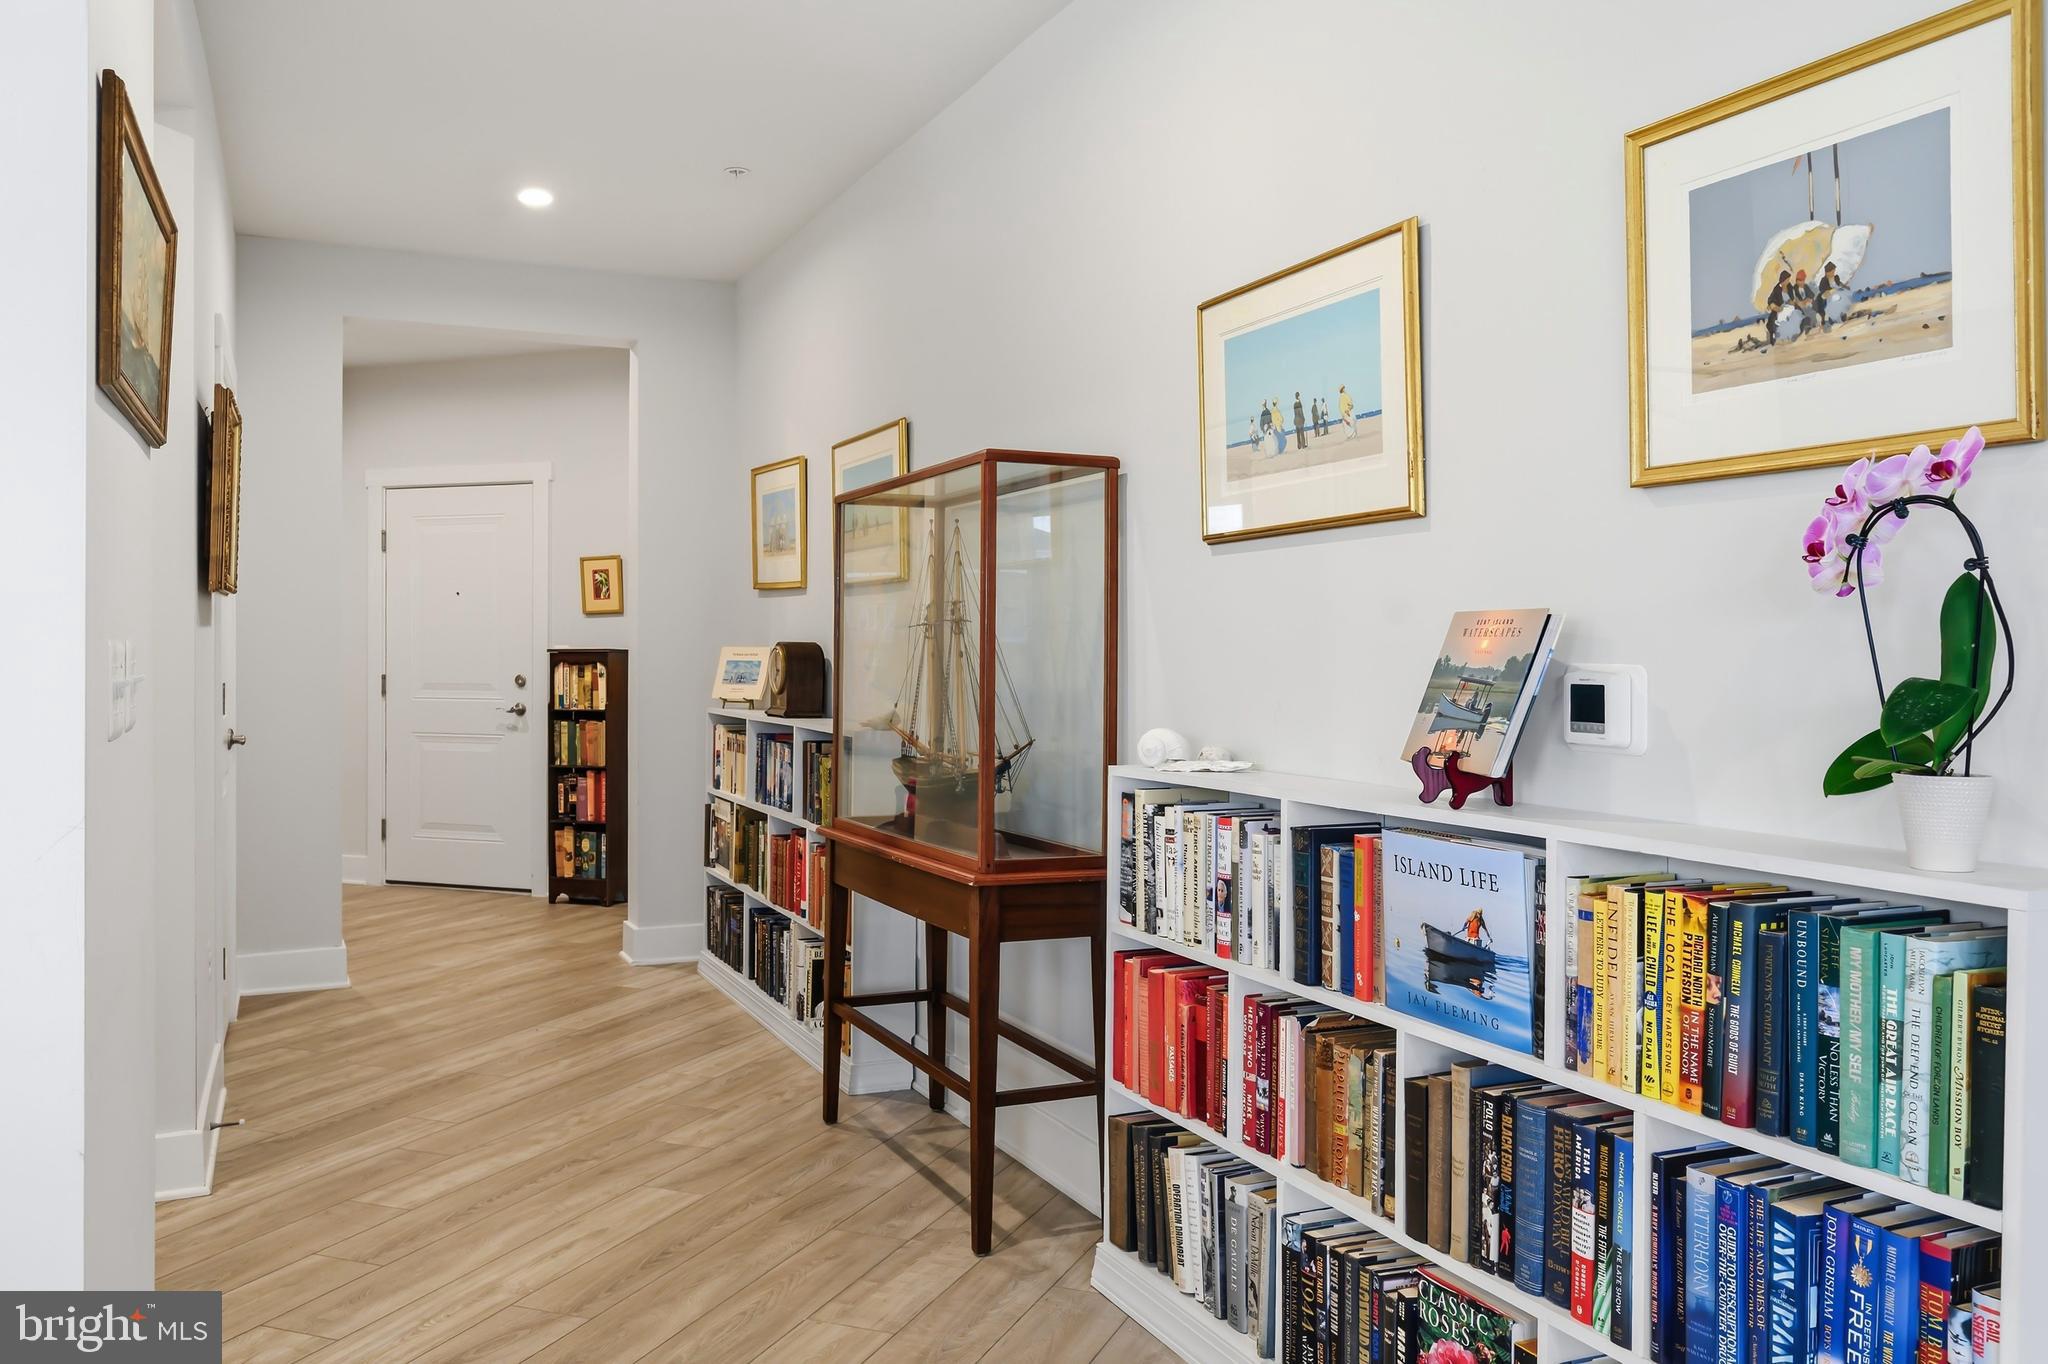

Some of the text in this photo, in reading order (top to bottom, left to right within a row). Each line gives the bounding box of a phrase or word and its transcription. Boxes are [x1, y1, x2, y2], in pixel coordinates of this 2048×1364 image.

[1462, 627, 1523, 638] WATERSCAPES
[1394, 854, 1500, 892] ISLAND LIFE
[1608, 900, 1618, 985] INFIDEL
[1646, 915, 1657, 934] LEE
[1666, 897, 1676, 983] THE LOCAL
[1596, 911, 1604, 999] LETTERS TO JUDY
[1646, 956, 1656, 987] CHILD
[1682, 932, 1692, 1005] PATTERSON
[1692, 934, 1704, 1007] RICHARD NORTH
[1710, 936, 1718, 972] HOFFMAN
[1731, 920, 1743, 996] MICHAEL CONNELLY
[1796, 920, 1808, 988] UNBOUND
[1407, 991, 1500, 1031] JAY FLEMING
[1646, 1020, 1653, 1034] NO
[1682, 1014, 1690, 1028] OF
[1850, 947, 1862, 1083] MY MOTHER/MY SELF
[1935, 1006, 1943, 1046] CHILDREN
[1689, 1011, 1700, 1084] IN THE NAME
[1728, 1004, 1740, 1075] THE GODS OF GUILT
[1885, 988, 1898, 1138] THE GREAT AIR RACE
[1934, 1048, 1942, 1059] OF
[1818, 1055, 1828, 1103] VICTORY
[1830, 1040, 1840, 1122] NO LESS THAN
[1907, 1008, 1922, 1146] THE DEEP END OCEAN
[1484, 1100, 1494, 1131] POLIO
[1501, 1114, 1512, 1150] BLACK
[1932, 1098, 1940, 1126] LANDS
[1954, 1066, 1965, 1150] MISSION BOY
[1372, 1156, 1379, 1165] IT
[1500, 1152, 1512, 1182] ECHO
[1598, 1144, 1608, 1220] MICHAEL CONNELLY
[1172, 1184, 1185, 1268] OPERATION DRUMBEAT
[1231, 1216, 1238, 1236] DE
[1552, 1183, 1562, 1248] DONOVAN
[1560, 1186, 1571, 1259] WILD BILL
[1250, 1213, 1260, 1278] Nelson DeMille
[1598, 1224, 1608, 1261] THE FIFTH
[1694, 1192, 1710, 1296] MATTERHORN
[1726, 1227, 1736, 1260] GUIDE
[1756, 1198, 1764, 1331] THE LIFE AND TIMES OF
[1773, 1222, 1795, 1290] AYN
[1823, 1212, 1837, 1320] JOHN GRISHAM
[1360, 1271, 1369, 1289] THE
[1676, 1235, 1684, 1322] SUPERIOR WOMEN
[1718, 1223, 1727, 1331] OVER-THE-COUNTER
[1726, 1262, 1736, 1276] TO
[1884, 1245, 1896, 1326] MICHAEL CONNELLY
[1301, 1276, 1314, 1332] 1944
[1330, 1292, 1338, 1336] MARTINI
[1418, 1280, 1488, 1336] CLASSIC
[1419, 1300, 1470, 1347] ROSES
[1726, 1278, 1736, 1355] PRESCRIPTION
[1864, 1302, 1872, 1314] IN
[1928, 1290, 1944, 1332] TOM
[1823, 1324, 1832, 1350] BOYS
[1883, 1330, 1894, 1347] THE
[1973, 1312, 1984, 1359] SHEEHY
[1987, 1319, 2000, 1344] GAIL
